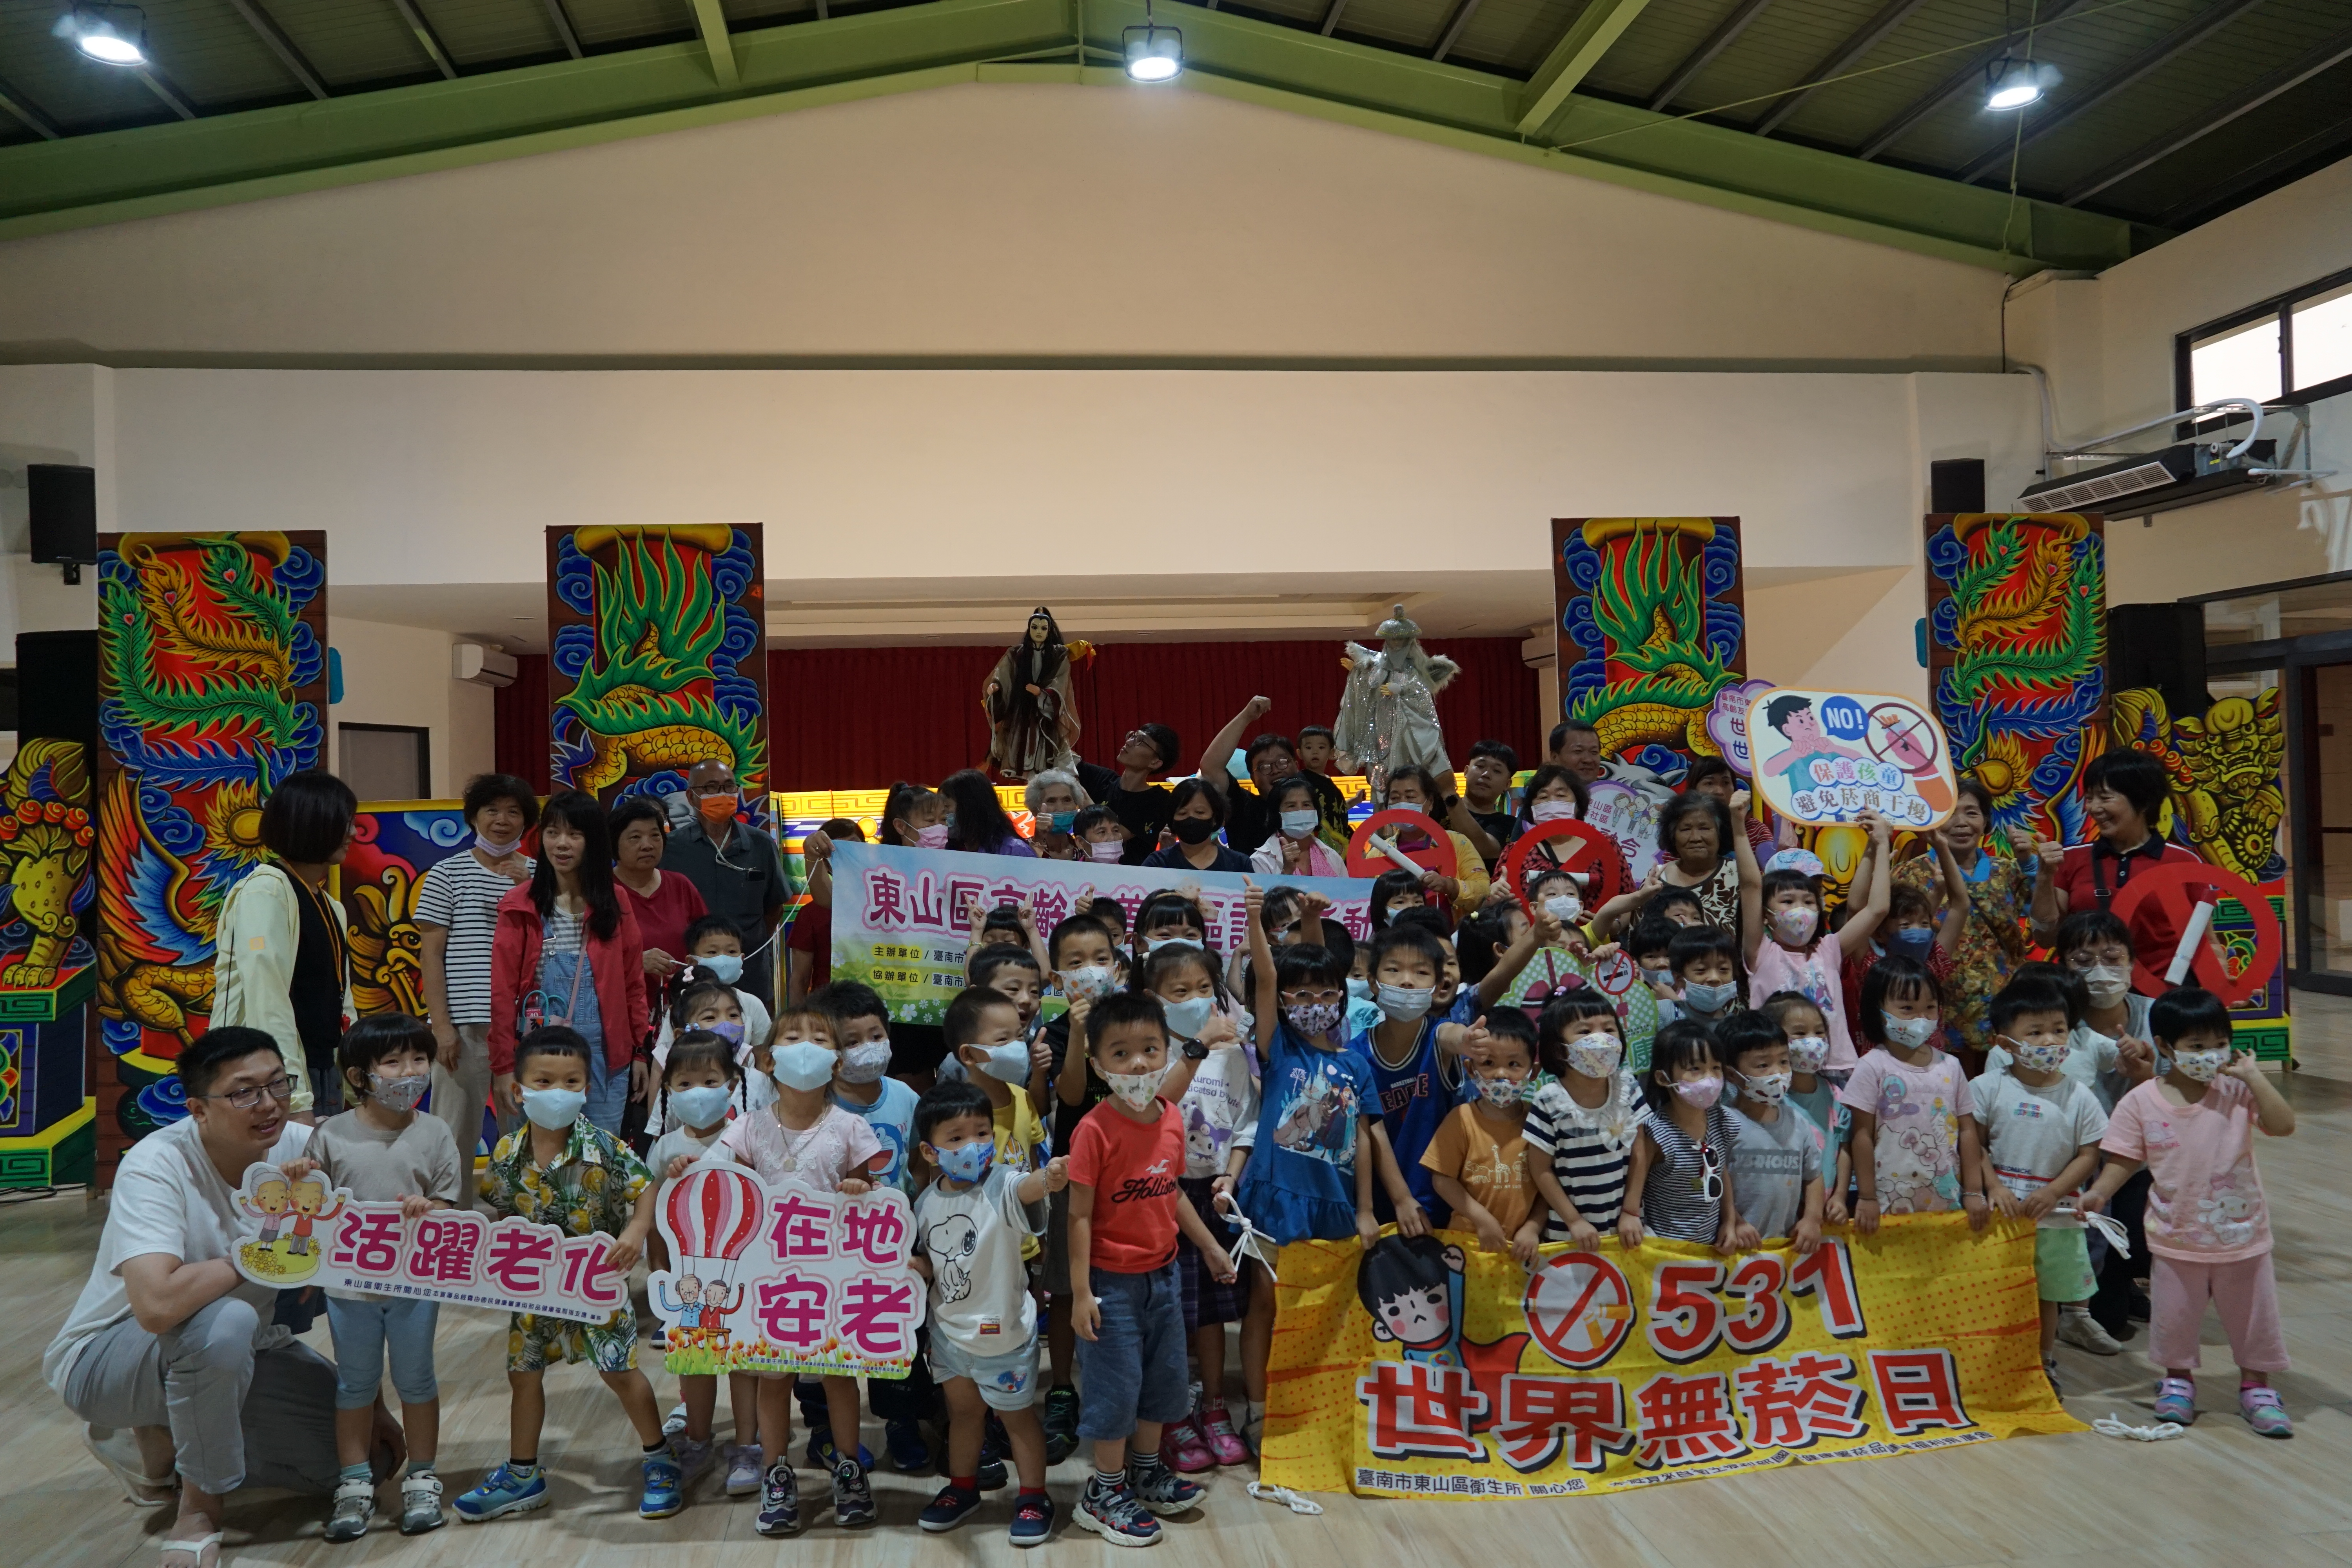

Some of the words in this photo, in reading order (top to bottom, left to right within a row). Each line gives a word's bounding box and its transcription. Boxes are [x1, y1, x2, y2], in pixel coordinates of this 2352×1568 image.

[1826, 707, 1864, 730] NO!
[1814, 763, 1898, 785] 保護孩童
[1795, 787, 1926, 820] 避免菸商干擾
[874, 946, 920, 959] 主辦單位
[873, 969, 918, 983] 協辦單位
[933, 973, 967, 987] 臺南市
[771, 1196, 903, 1265] 在地
[336, 1211, 621, 1301] 活躍老化
[344, 1278, 432, 1297] 東山區衛生所關心您
[1651, 1238, 1863, 1355] 531
[759, 1273, 911, 1353] 安老
[1360, 1347, 1973, 1468] 世界無菸日
[1357, 1469, 1521, 1495] 臺南市東山區衛生所
[1530, 1479, 1586, 1495] 關心您
